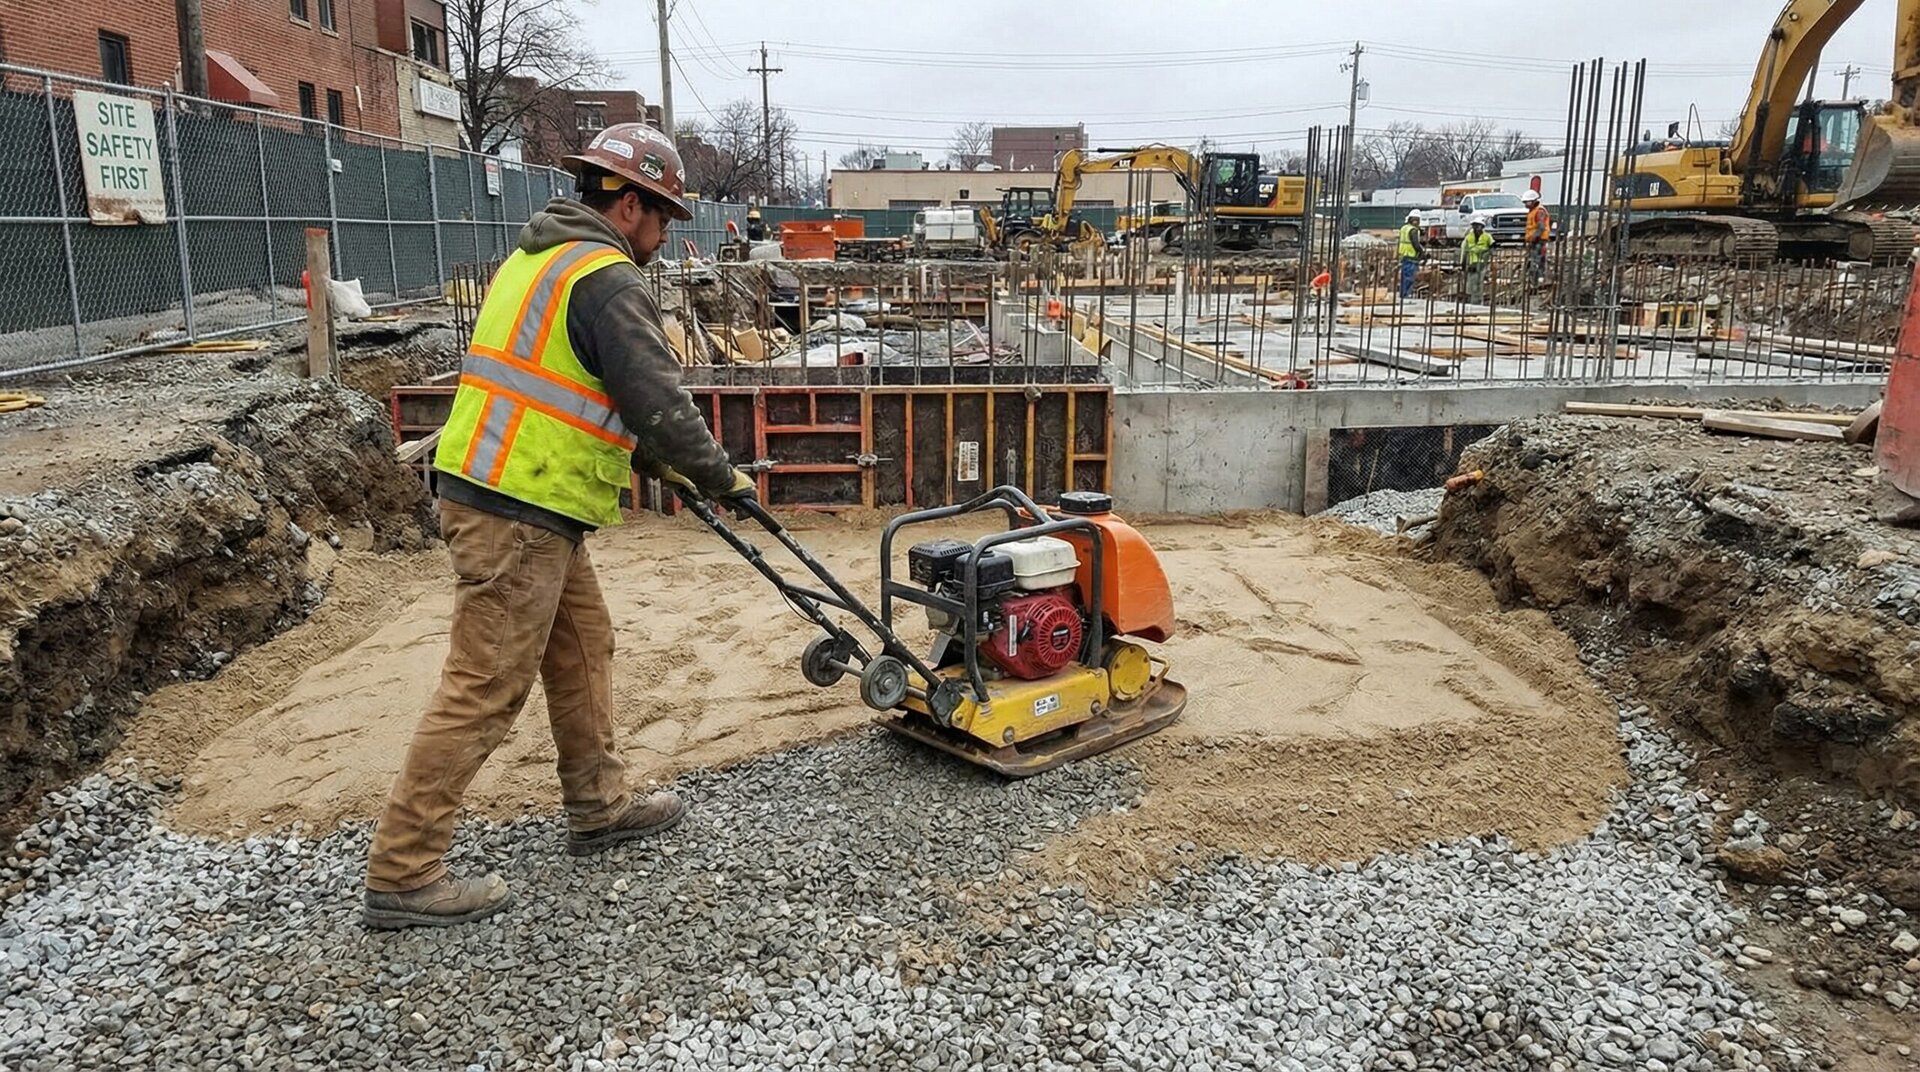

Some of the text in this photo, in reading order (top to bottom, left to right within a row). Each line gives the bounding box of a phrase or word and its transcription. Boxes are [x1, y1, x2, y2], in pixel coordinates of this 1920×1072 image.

[97, 101, 136, 128] SITE
[86, 132, 152, 160] SAFETY
[100, 165, 148, 190] FIRST
[1258, 183, 1275, 193] CAT
